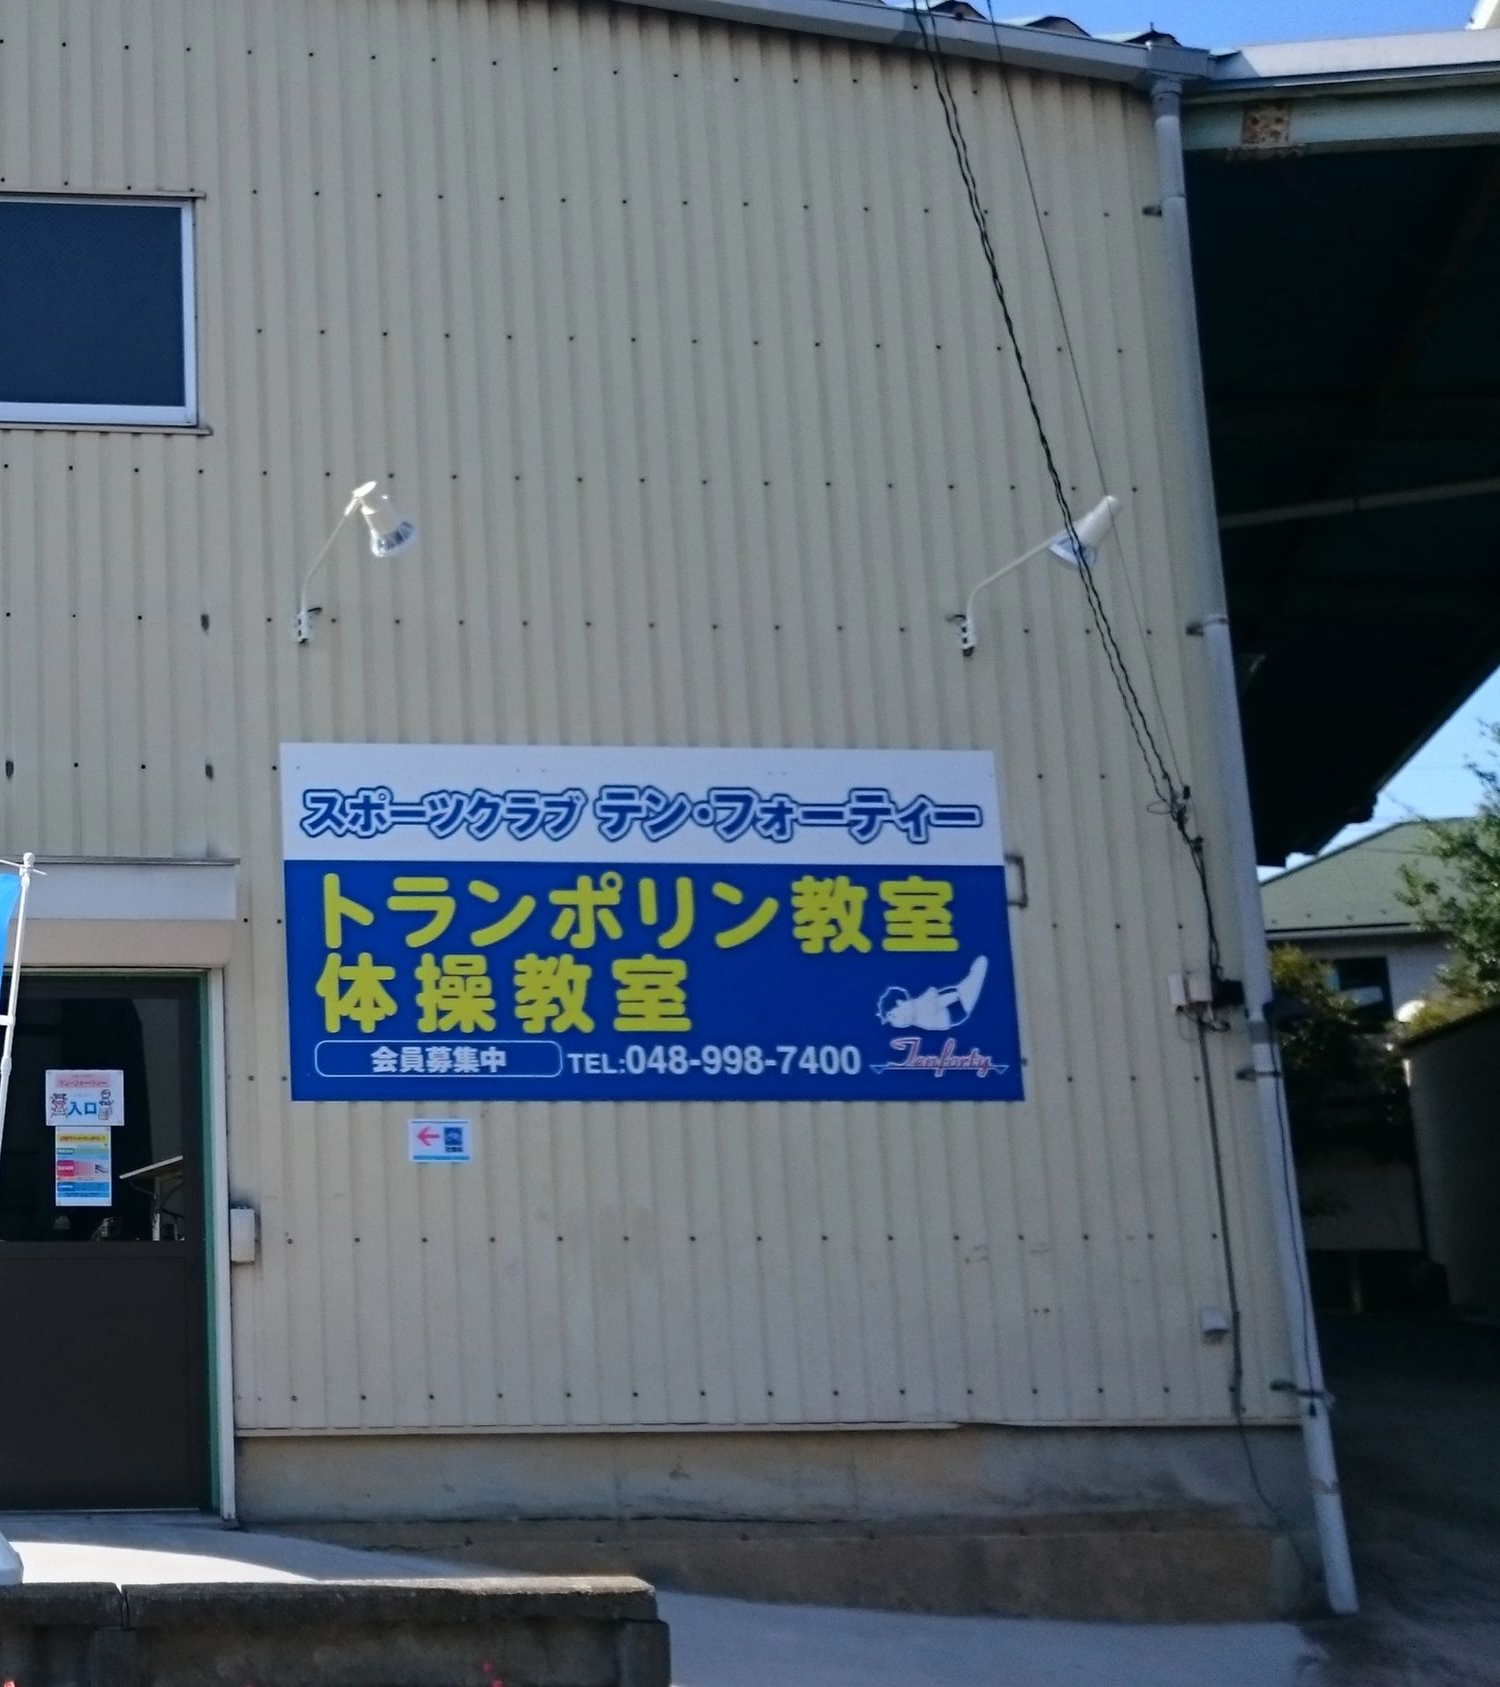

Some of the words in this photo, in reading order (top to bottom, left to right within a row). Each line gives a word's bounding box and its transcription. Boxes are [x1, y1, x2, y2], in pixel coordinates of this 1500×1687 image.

[300, 786, 586, 841] スポーツクラブ
[595, 785, 982, 843] テン・フォーティー
[323, 871, 960, 954] トランポリン教室
[316, 952, 692, 1033] 体操教室
[371, 1046, 507, 1074] 会員募集中
[67, 1101, 97, 1116] 入口
